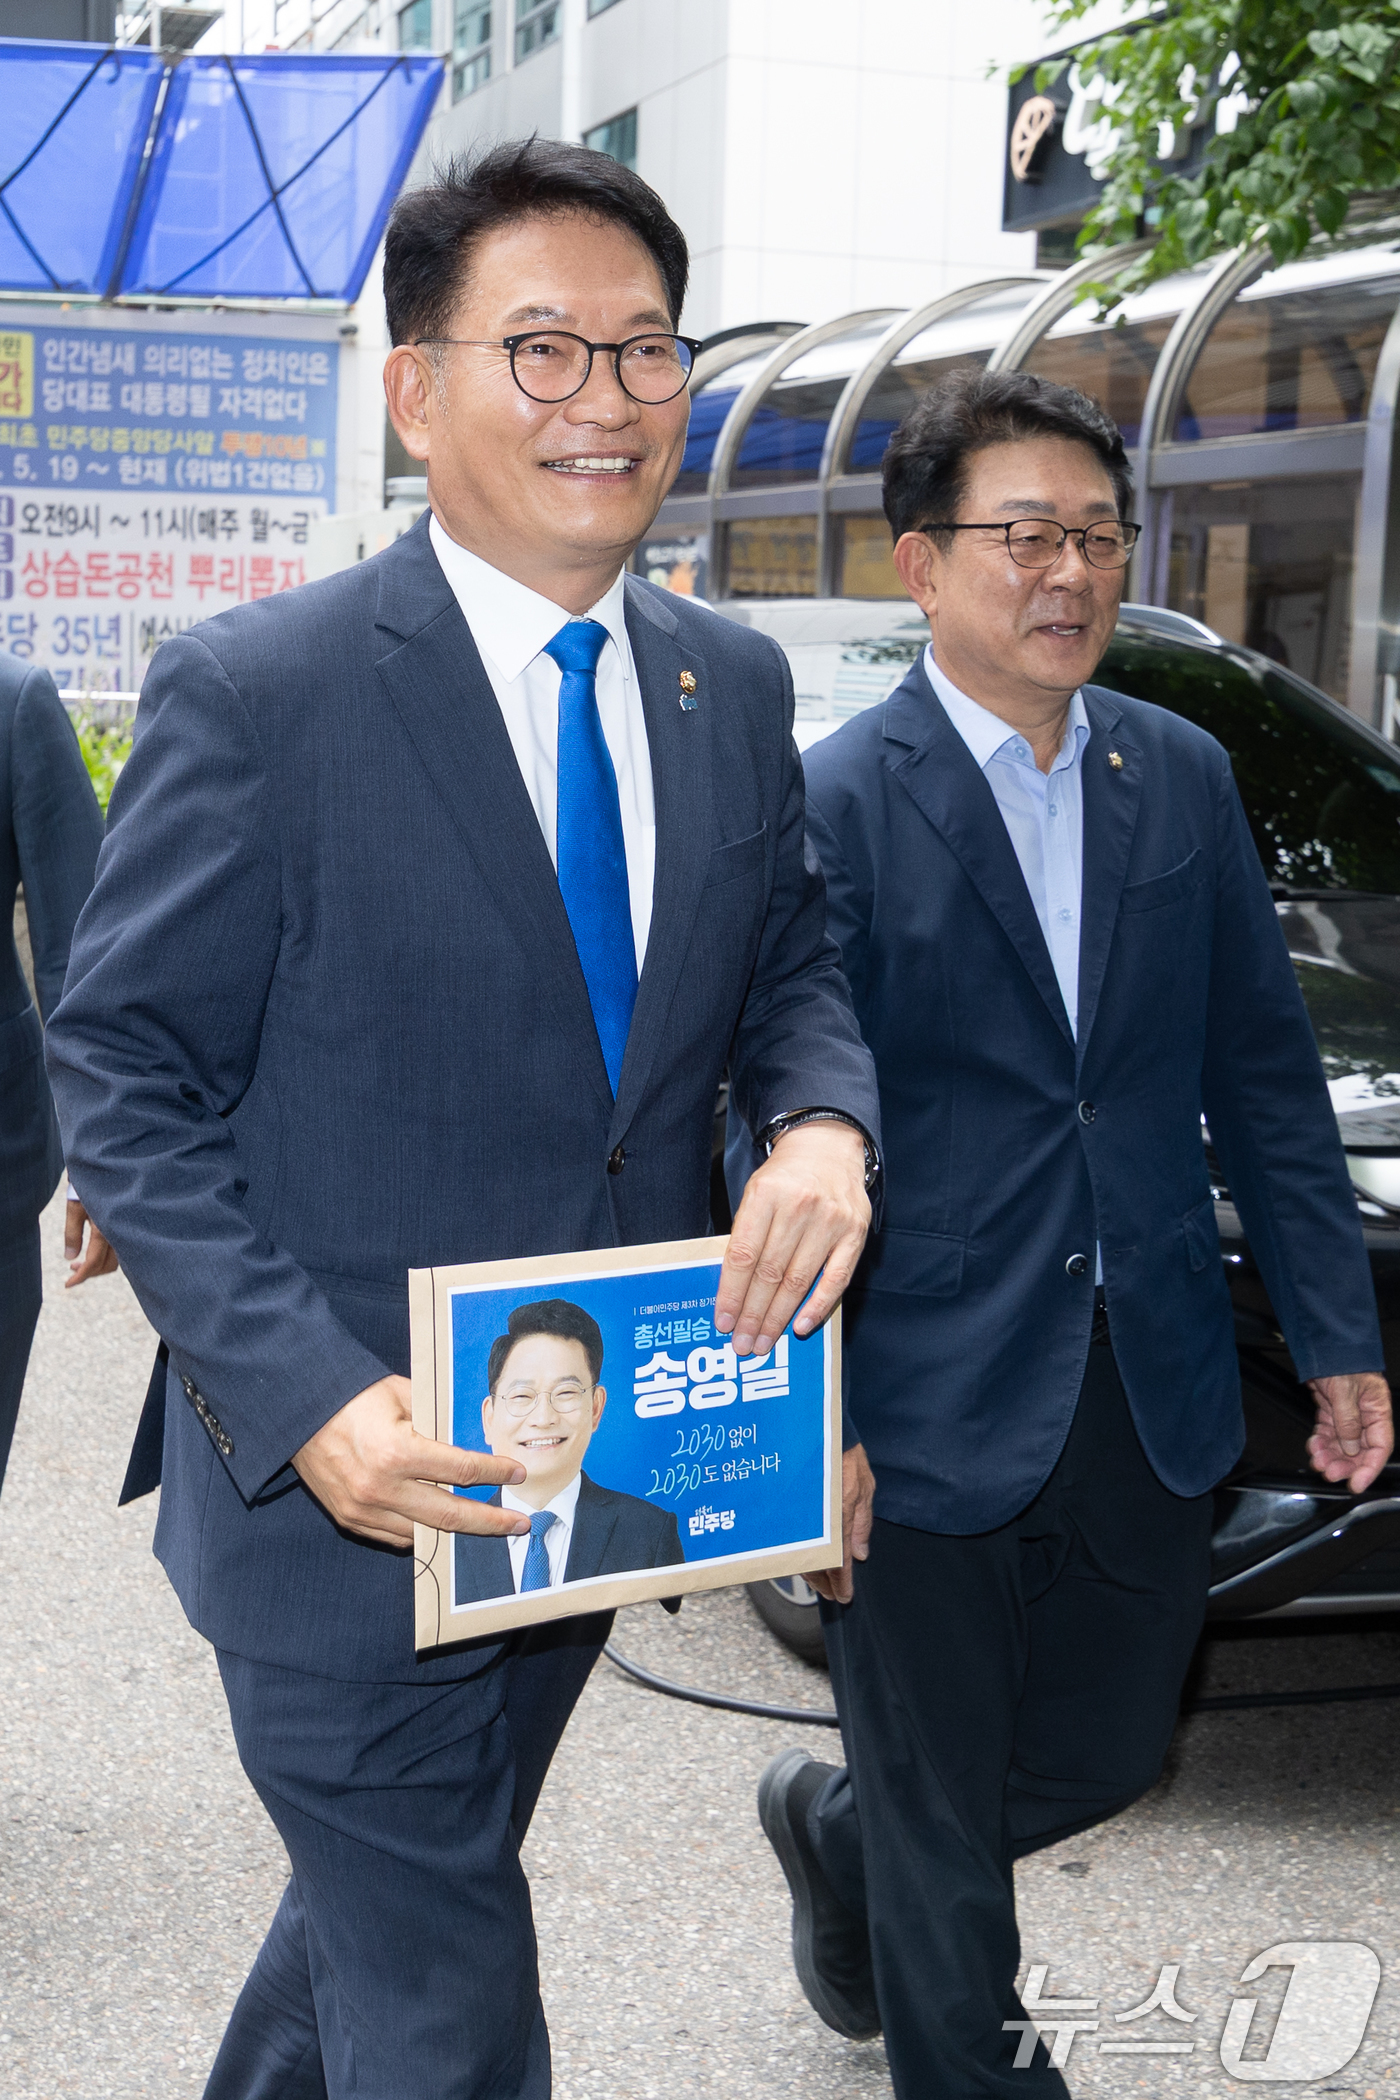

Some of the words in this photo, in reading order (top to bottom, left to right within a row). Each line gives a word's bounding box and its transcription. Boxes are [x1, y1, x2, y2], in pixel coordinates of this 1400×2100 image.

[43, 338, 136, 376] 인간냄새
[143, 344, 234, 381] 의리없는
[241, 350, 331, 386] 정치인은
[42, 378, 112, 413] 당대표
[218, 387, 307, 423] 자격없다
[49, 455, 79, 482] 19
[119, 456, 167, 486] 현재
[19, 503, 100, 539] 오전9시
[249, 509, 320, 545] 월~금
[22, 550, 174, 600] 상습돈공천
[187, 555, 306, 602] 뿌리뽑자
[52, 613, 121, 658] 35년
[639, 1303, 680, 1315] 더불어민주당
[680, 1301, 698, 1310] 제3차
[634, 1317, 711, 1350] 총선필승
[633, 1334, 789, 1419] 송영길
[671, 1423, 726, 1462] 2030
[728, 1423, 757, 1449] 없이
[721, 1452, 781, 1483] 없습니다
[688, 1509, 736, 1537] 민주당
